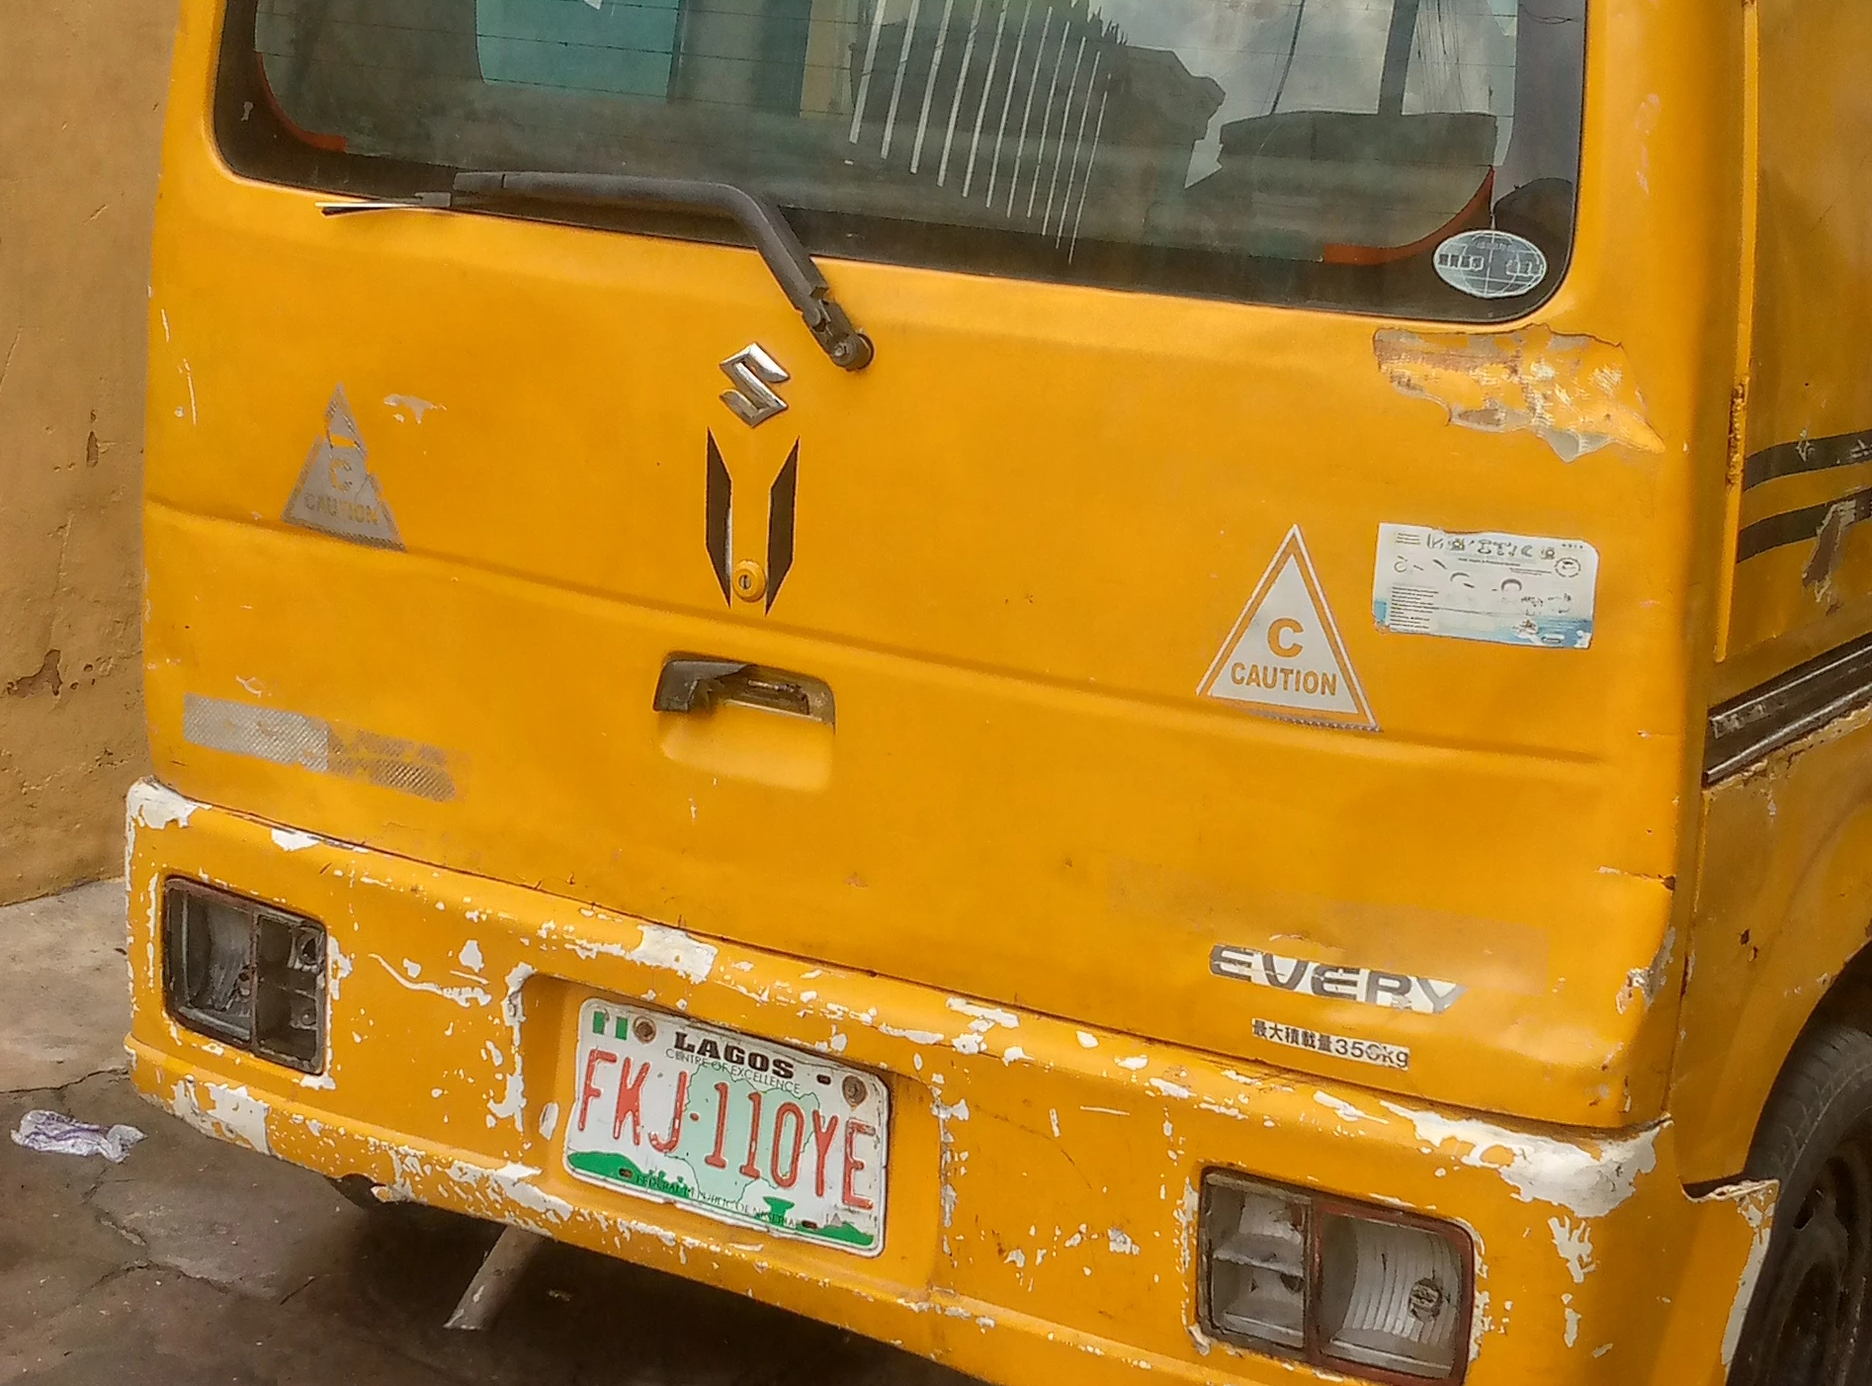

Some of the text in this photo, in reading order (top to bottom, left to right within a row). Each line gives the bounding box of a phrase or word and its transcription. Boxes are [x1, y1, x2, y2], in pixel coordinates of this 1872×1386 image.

[330, 458, 353, 493] C
[303, 491, 380, 526] CAUTION
[1266, 616, 1305, 658] C
[1229, 661, 1338, 696] CAUTION
[1209, 943, 1468, 1014] EVERY
[665, 1047, 801, 1095] CENTRE OF EXCELLENCE
[673, 1030, 795, 1080] LAGOS
